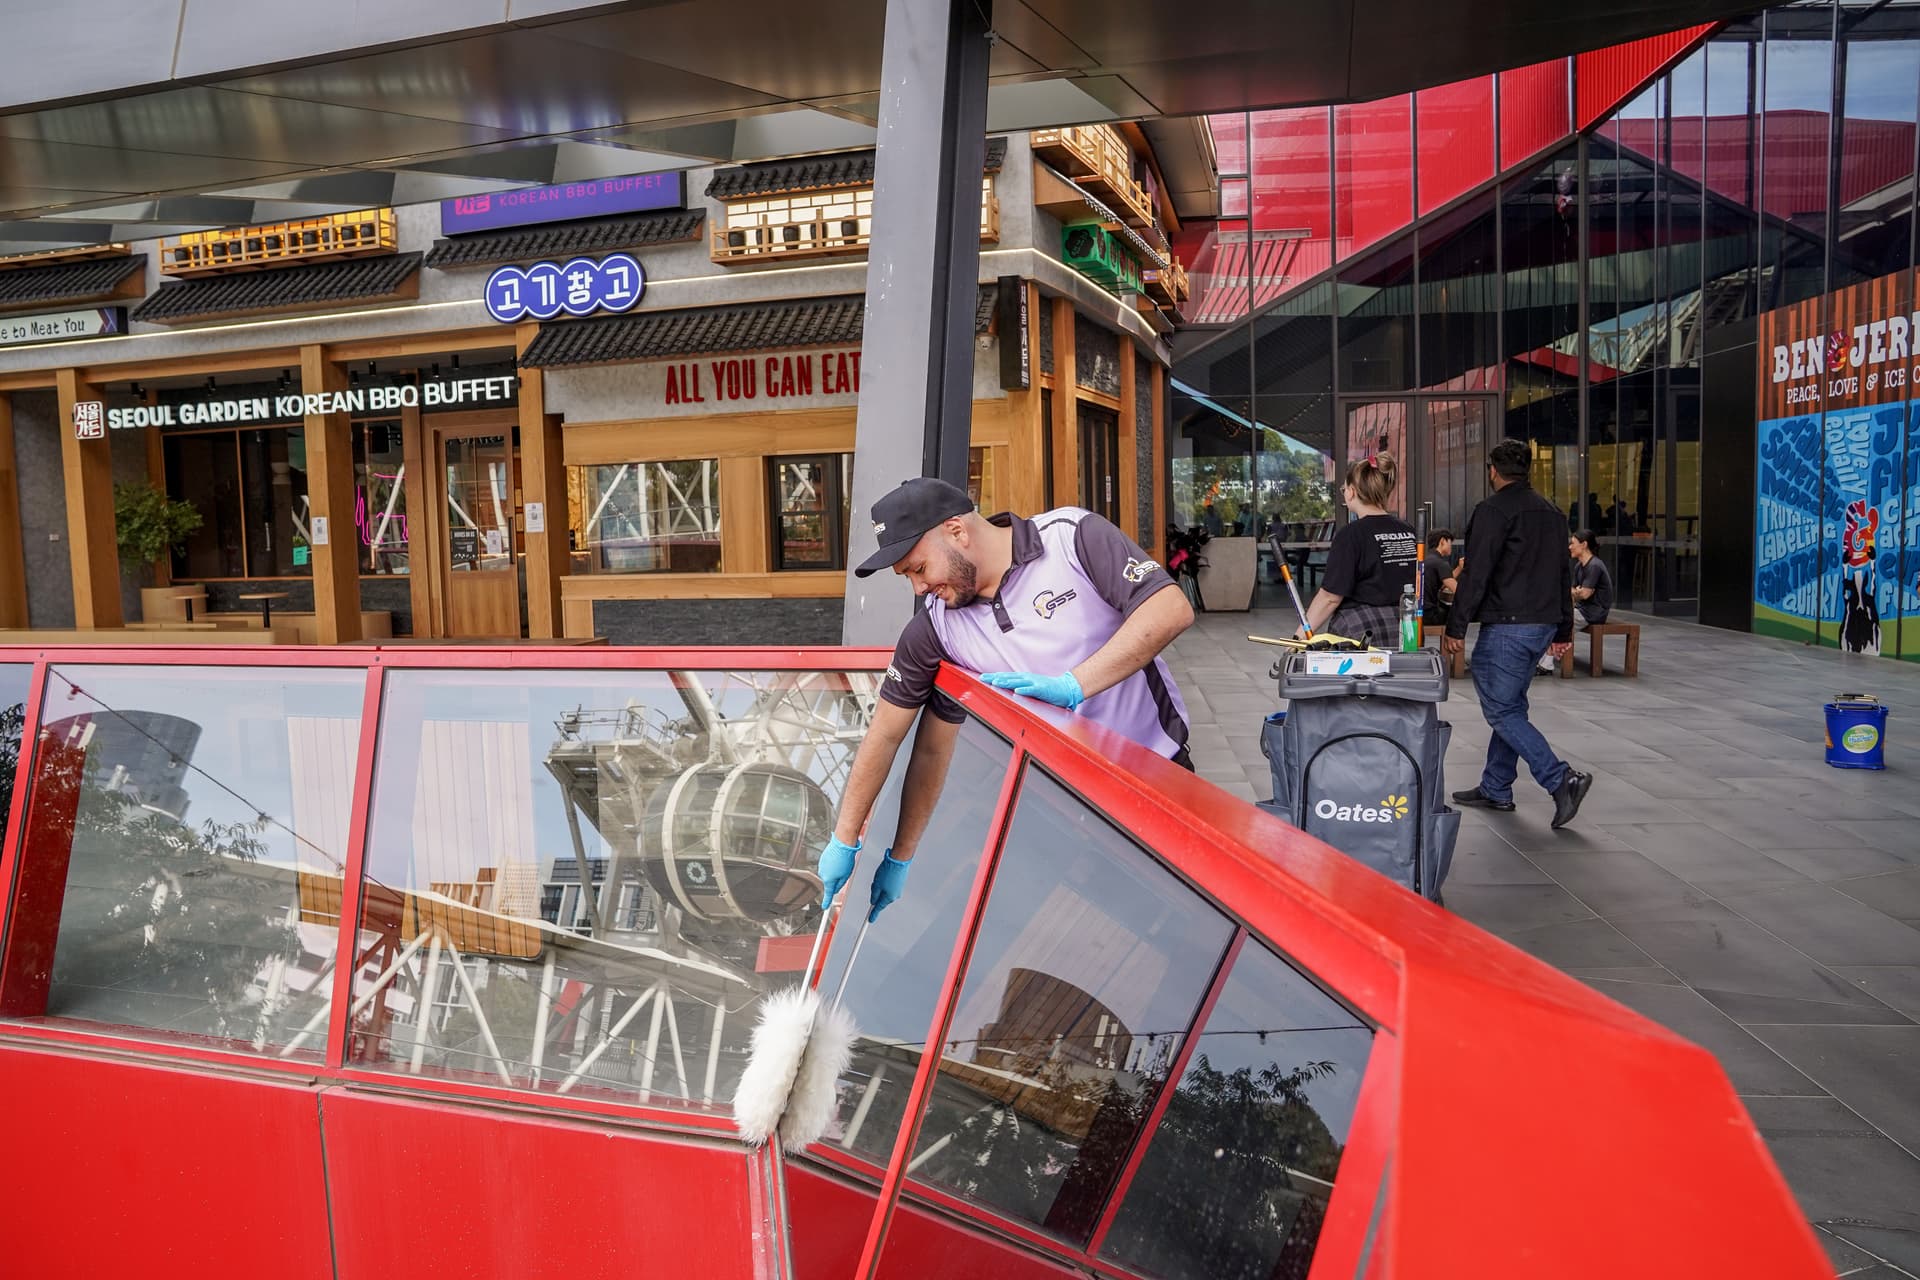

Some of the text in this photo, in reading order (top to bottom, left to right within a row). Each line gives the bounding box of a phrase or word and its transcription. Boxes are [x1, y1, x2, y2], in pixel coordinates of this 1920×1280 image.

[499, 174, 664, 207] KOREAN BBQ BUFFET
[496, 265, 631, 312] 고기창고
[12, 325, 26, 338] to
[30, 320, 60, 337] Meat
[63, 316, 86, 333] You
[1772, 335, 1824, 383] BEN
[665, 351, 862, 405] ALL YOU CAN EAT
[1786, 384, 1821, 404] PEACE,
[1828, 376, 1858, 397] LOVE
[1866, 372, 1878, 391] &
[1884, 368, 1906, 388] ICE
[107, 376, 515, 429] SEOUL GARDEN KOREAN BBQ BUFFET
[1045, 588, 1077, 611] GSS
[1314, 799, 1393, 823] Oates
